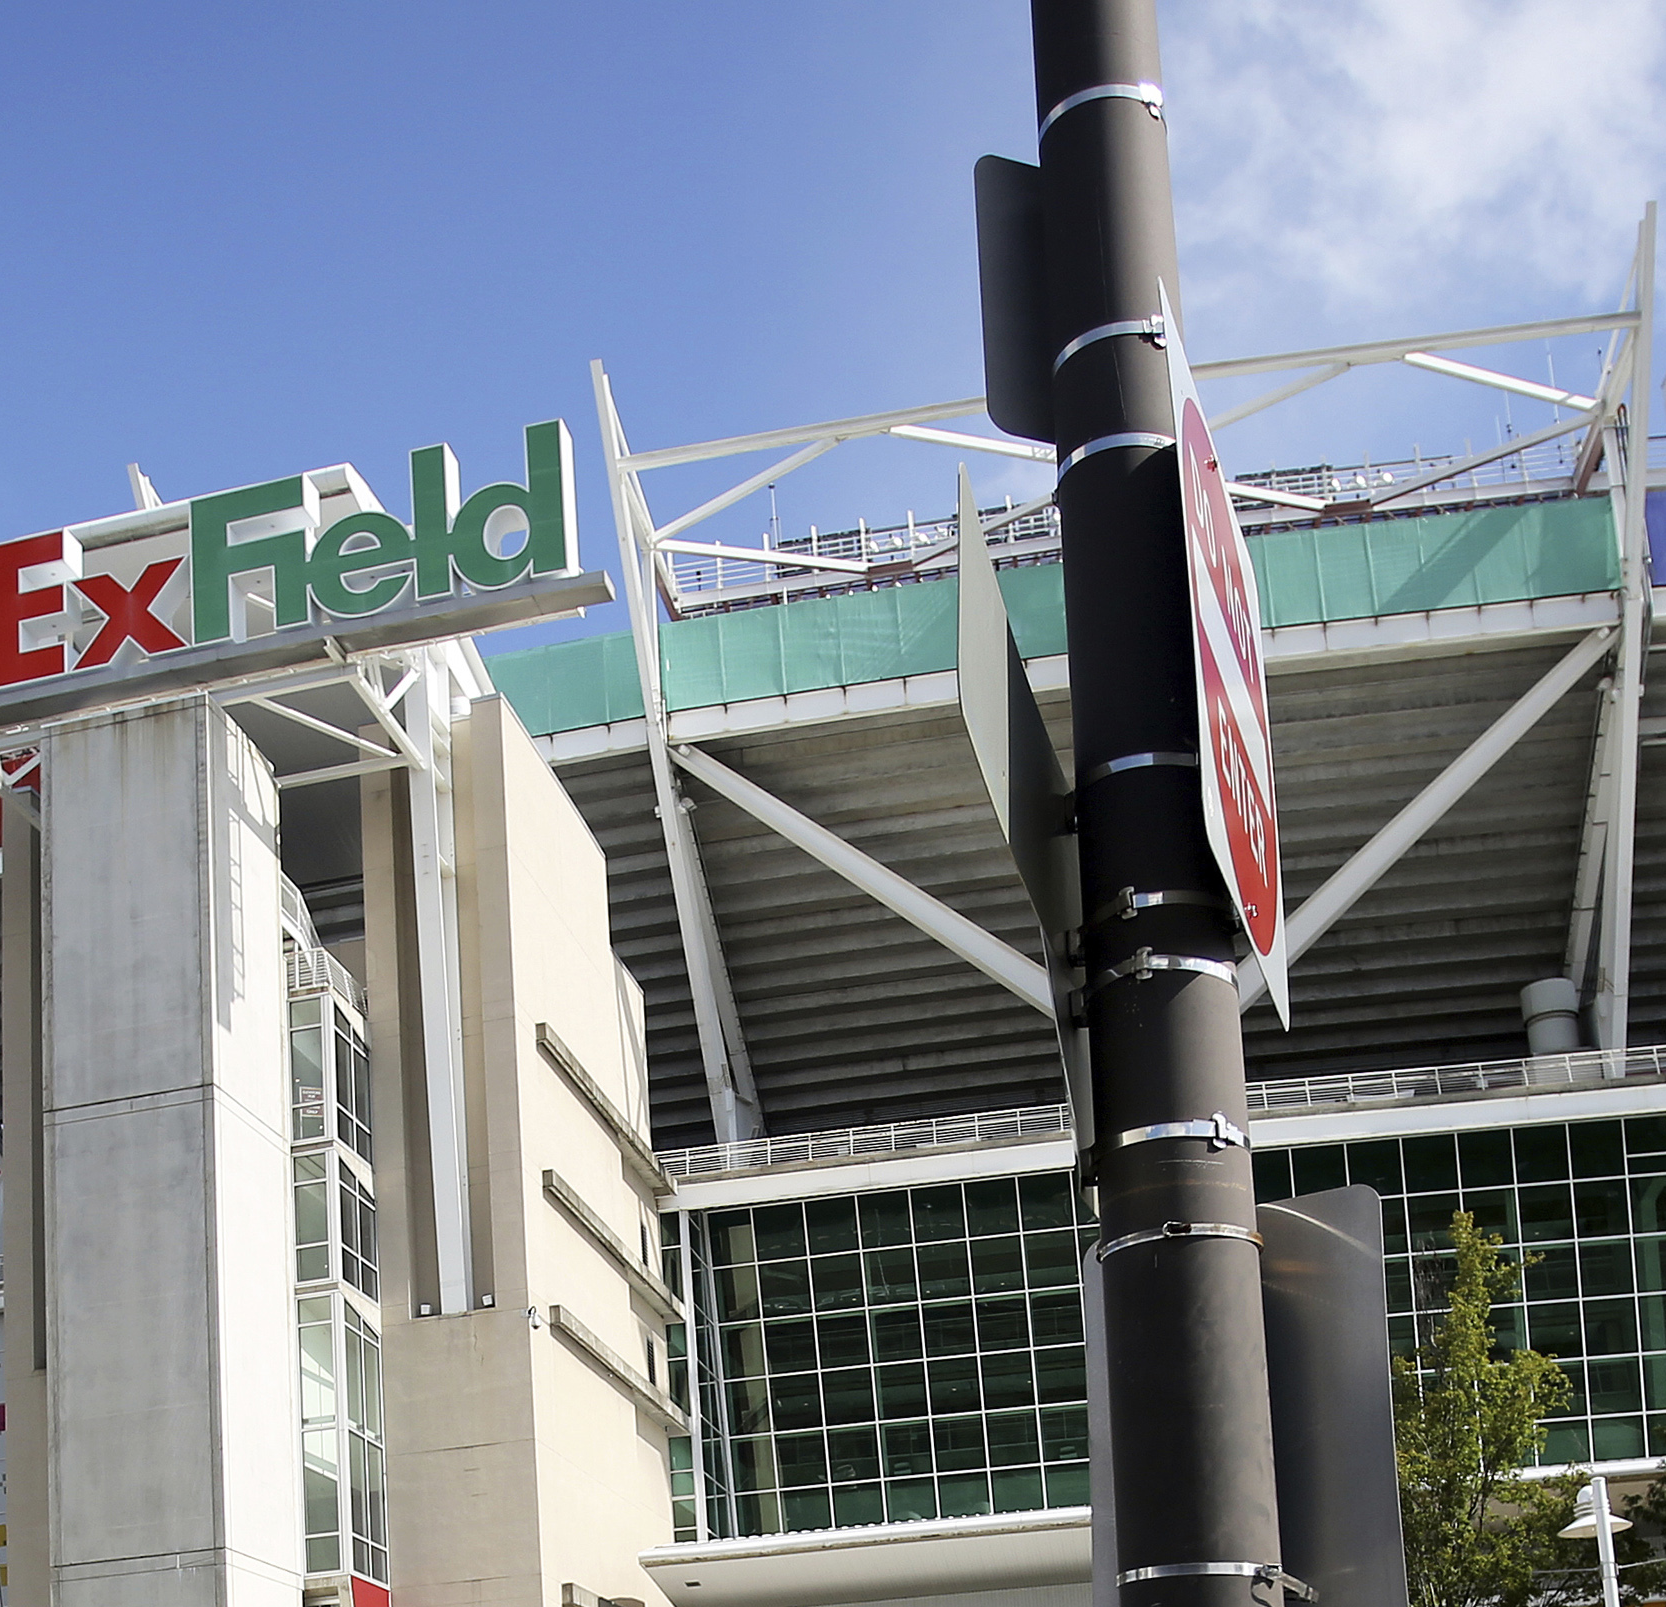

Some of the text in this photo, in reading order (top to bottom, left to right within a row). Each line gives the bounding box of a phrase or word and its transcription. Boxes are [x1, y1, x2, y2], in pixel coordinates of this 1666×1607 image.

[1189, 441, 1217, 568] DO
[1220, 545, 1254, 684] NOT
[1217, 695, 1268, 889] ENTER
